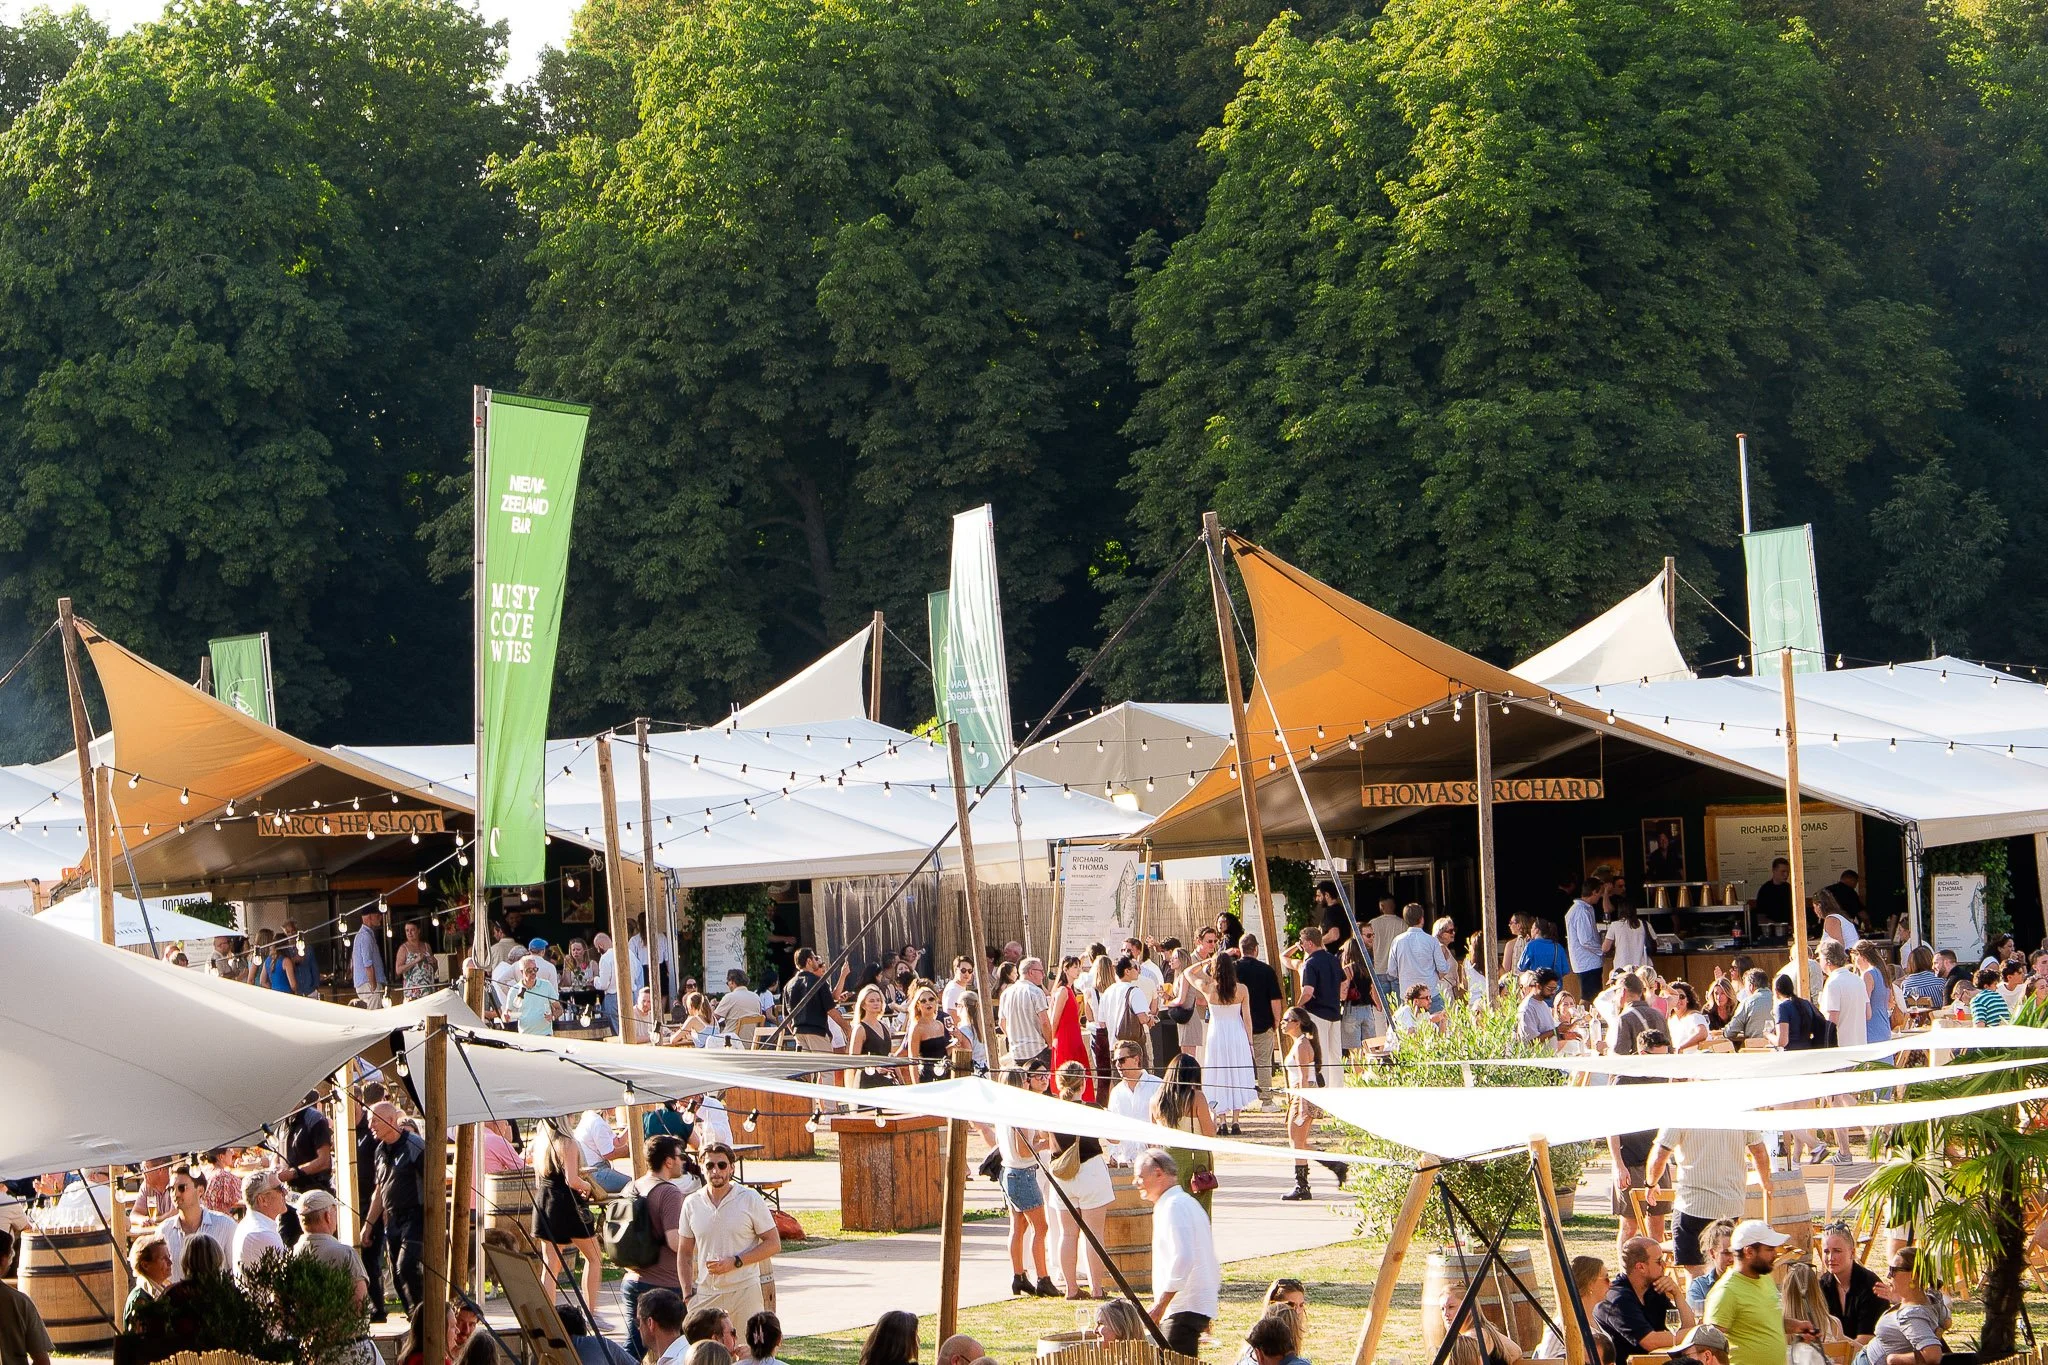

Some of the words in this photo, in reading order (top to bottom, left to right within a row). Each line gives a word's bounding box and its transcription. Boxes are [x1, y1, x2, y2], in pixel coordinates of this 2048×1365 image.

[491, 582, 540, 611] MISTY
[490, 611, 534, 639] COVE
[1364, 782, 1464, 806] THOMAS
[1491, 779, 1600, 801] RICHARD
[339, 812, 440, 834] HELSLOOT
[1740, 824, 1780, 835] RICHARD
[1782, 824, 1789, 833] &
[1079, 863, 1109, 871] THOMAS
